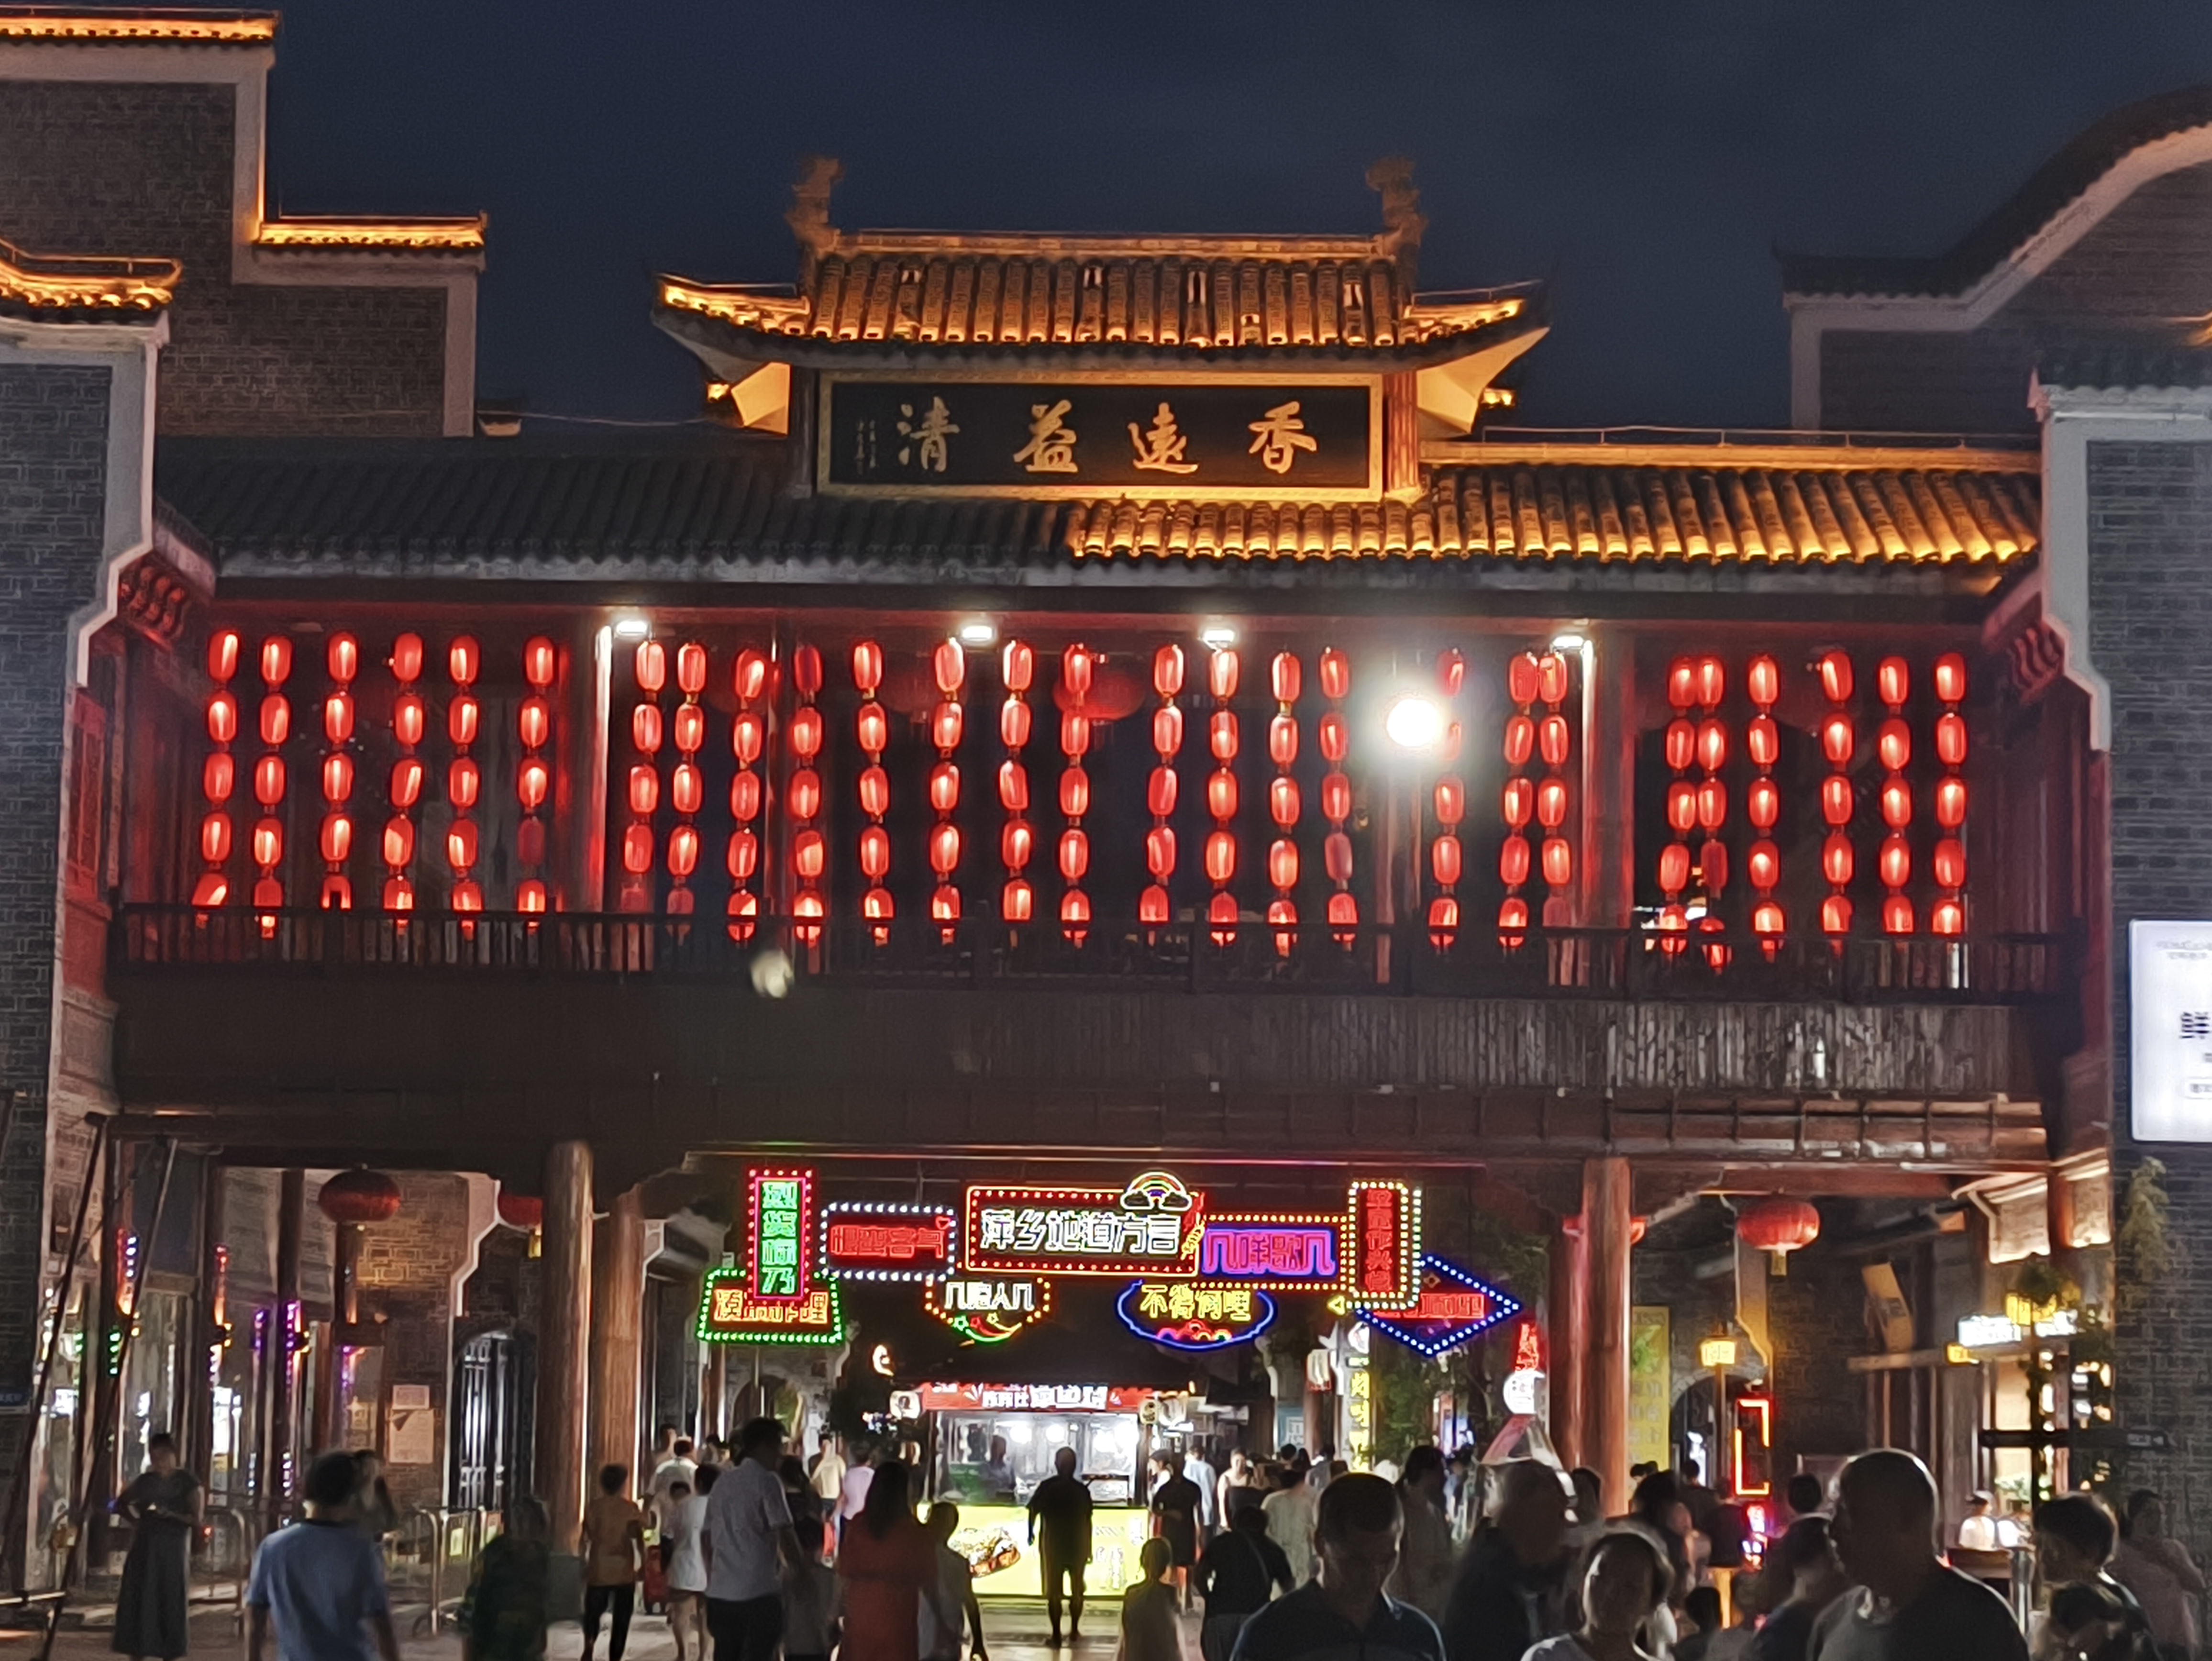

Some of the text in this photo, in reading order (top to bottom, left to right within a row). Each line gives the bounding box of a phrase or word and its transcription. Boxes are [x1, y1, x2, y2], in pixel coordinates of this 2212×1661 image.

[980, 1209, 1181, 1253] 萍乡地道方言
